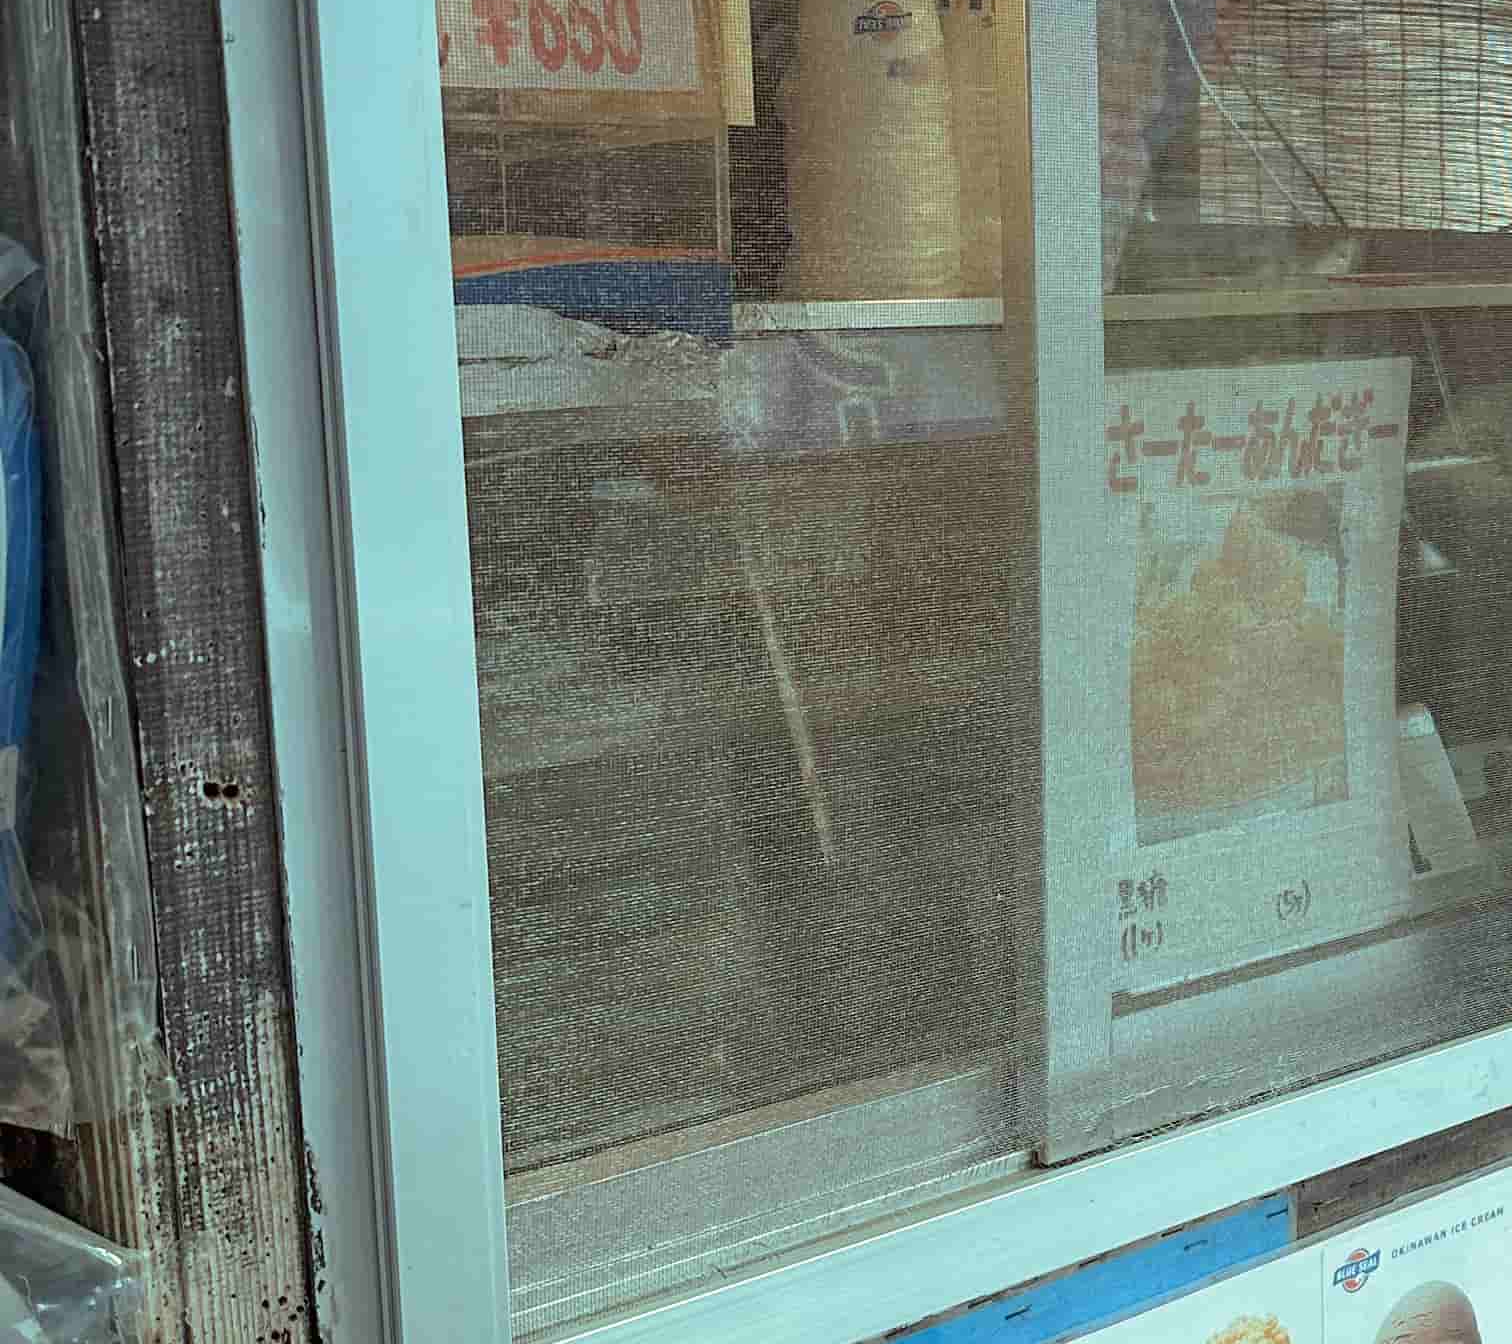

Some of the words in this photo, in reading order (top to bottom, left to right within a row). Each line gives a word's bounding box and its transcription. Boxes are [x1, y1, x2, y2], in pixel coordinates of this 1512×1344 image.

[1391, 1229, 1447, 1258] OKINAWAN
[1451, 1220, 1467, 1235] ICE
[1471, 1206, 1504, 1227] CREAM
